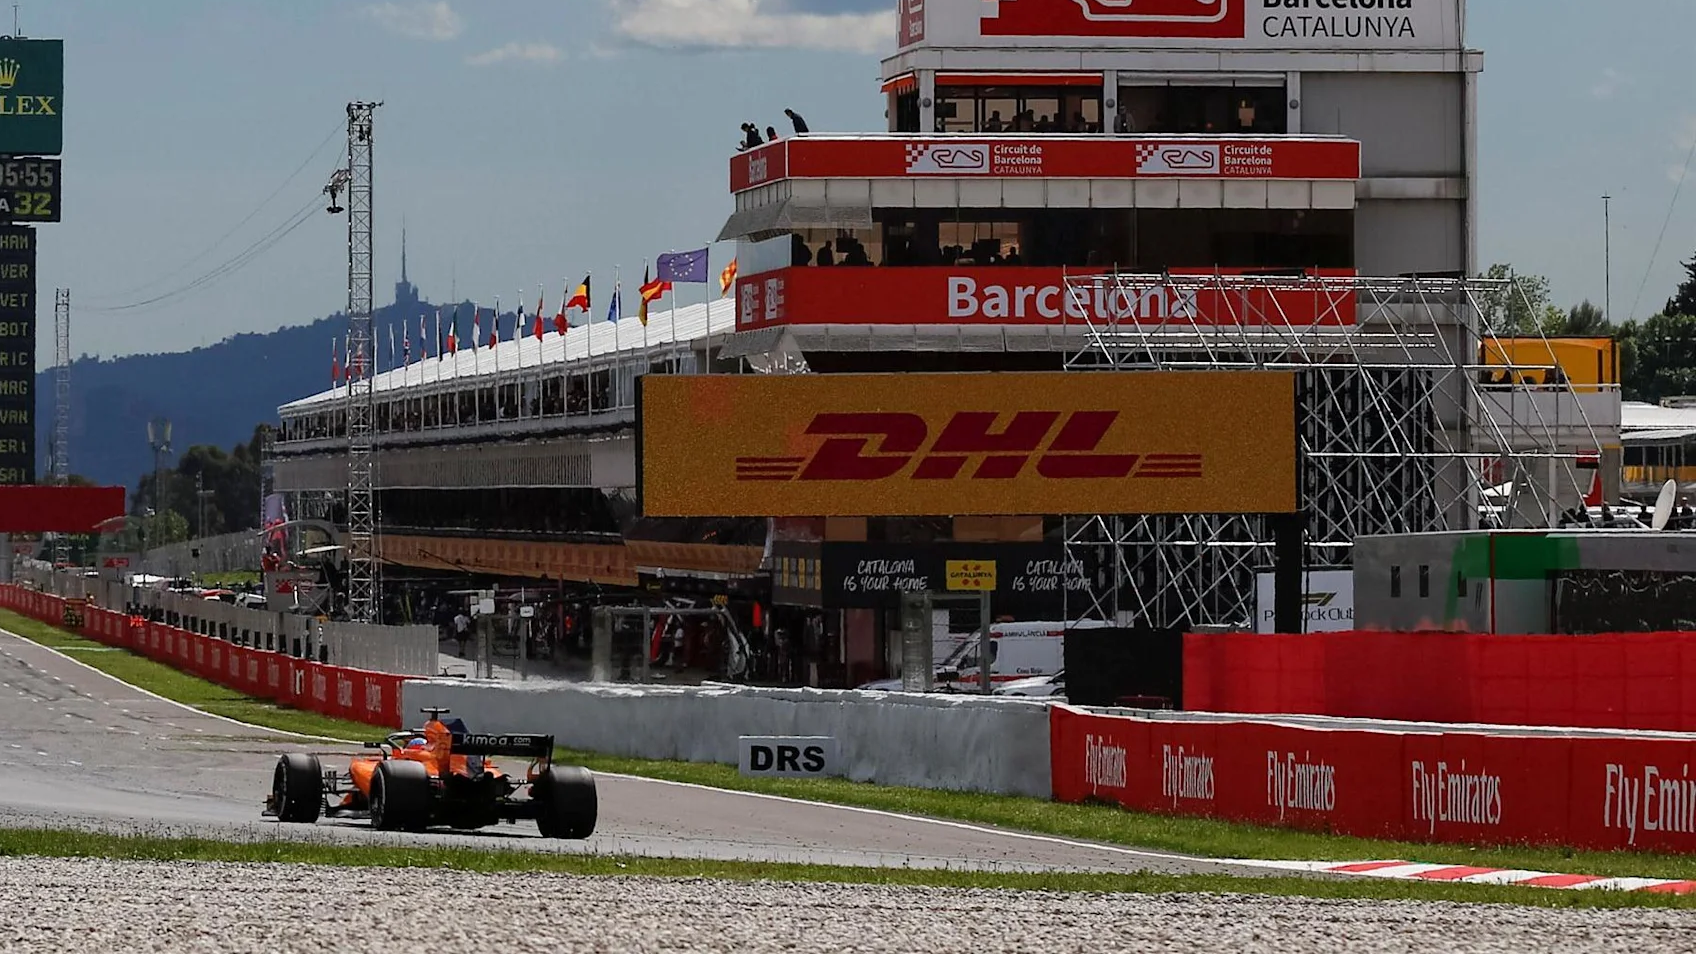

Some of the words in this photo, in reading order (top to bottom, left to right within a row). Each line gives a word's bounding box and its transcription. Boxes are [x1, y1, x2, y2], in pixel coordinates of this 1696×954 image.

[1263, 16, 1415, 38] CATALUNYA
[994, 144, 1028, 154] Circuit
[1029, 144, 1042, 154] de
[1224, 144, 1259, 155] Circuit
[1260, 145, 1272, 155] de
[994, 155, 1042, 165] Barcelona
[1224, 156, 1272, 165] Barcelona
[994, 166, 1042, 174] CATALUNYA
[1224, 166, 1272, 174] CATALUNYA
[14, 192, 52, 216] 32
[0, 235, 28, 249] HAM
[0, 263, 28, 278] VER
[0, 293, 28, 308] VET
[947, 276, 1198, 318] Barcelona
[0, 322, 28, 336] BOT
[0, 351, 28, 366] RIC
[0, 381, 27, 395] MAG
[0, 439, 26, 453] ERI
[798, 411, 1139, 480] DHL
[0, 468, 26, 482] SAI
[844, 576, 857, 591] IS
[861, 575, 889, 592] YOUR
[894, 576, 928, 591] HOME
[1012, 576, 1025, 591] IS
[1029, 576, 1058, 592] YOUR
[751, 746, 825, 772] DRS
[1085, 734, 1097, 795] Fly
[1098, 735, 1126, 788] Emirates
[1163, 745, 1177, 808] Fly
[1178, 744, 1214, 799] Emirates
[1267, 750, 1285, 821] Fly
[1287, 750, 1335, 811] Emirates
[1412, 760, 1435, 835] Fly
[1437, 759, 1501, 824] Emirates
[1604, 764, 1639, 845] Fly
